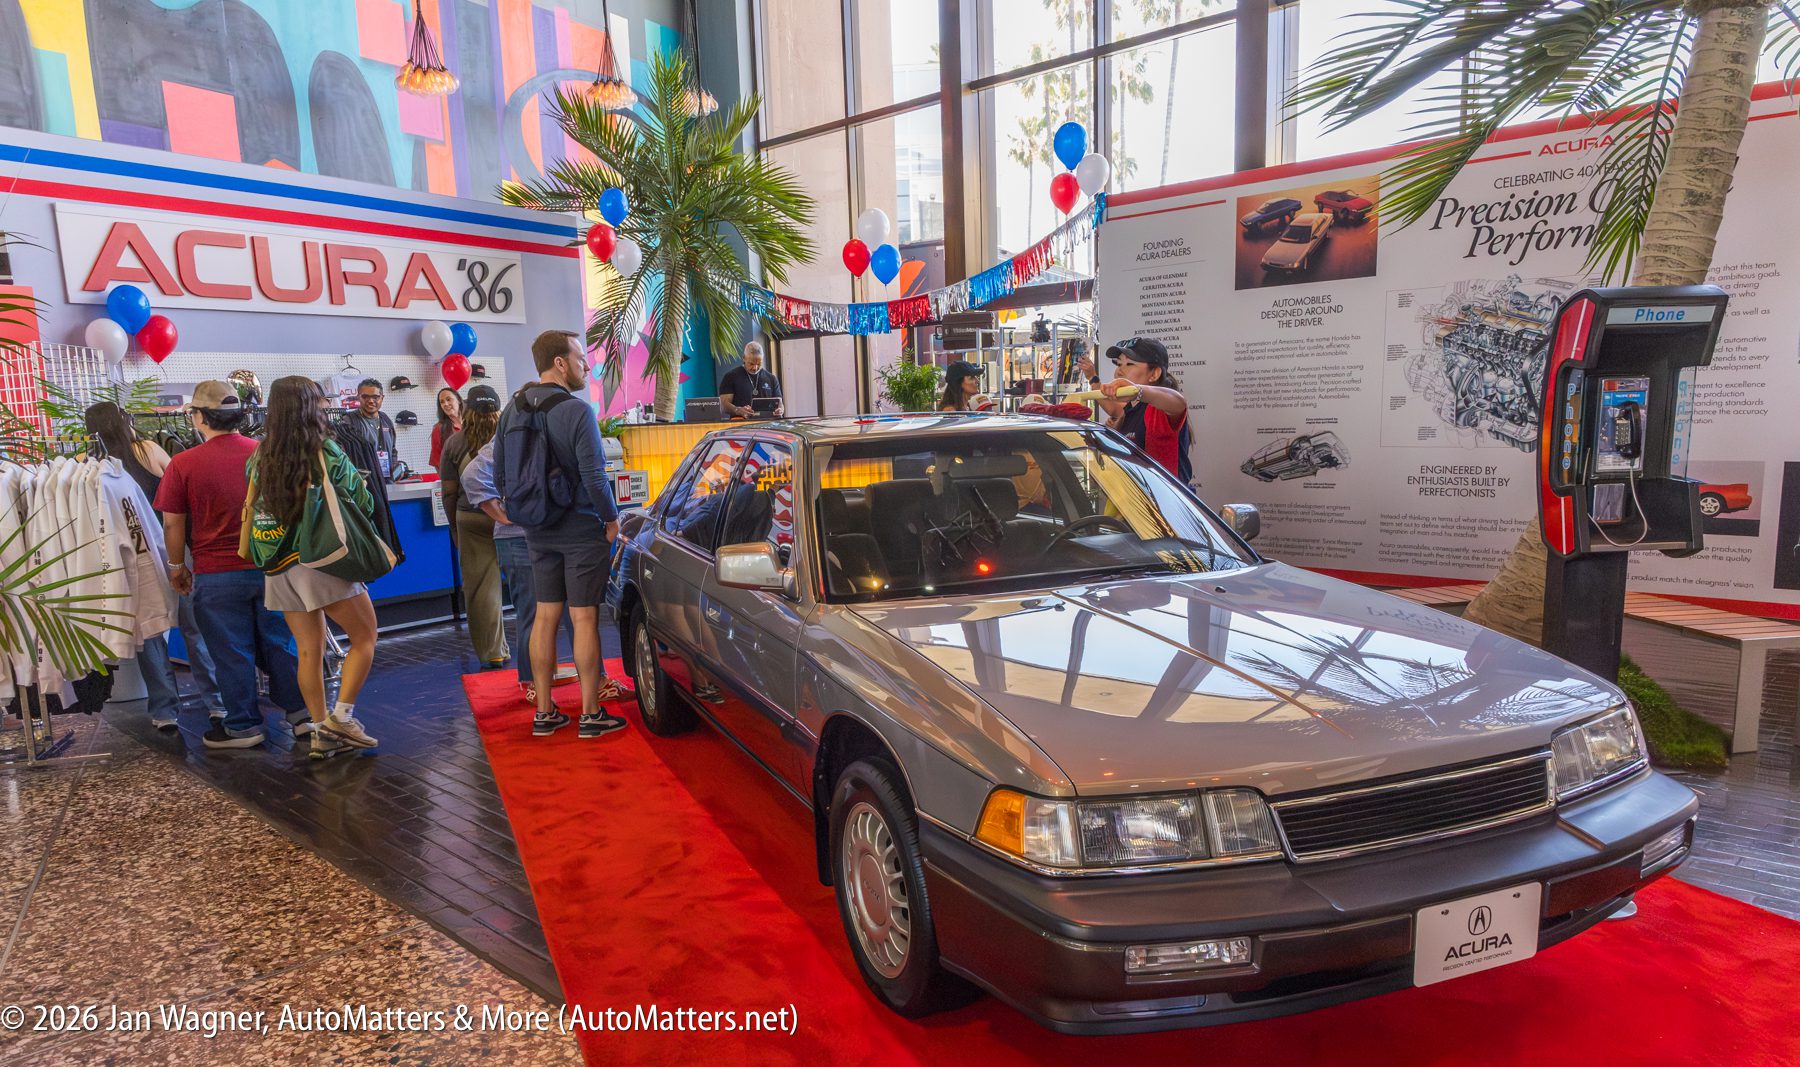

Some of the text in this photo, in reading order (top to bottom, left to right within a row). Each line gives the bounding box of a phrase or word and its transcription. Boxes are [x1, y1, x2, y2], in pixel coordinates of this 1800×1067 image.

[1538, 135, 1616, 157] ACURA
[1494, 168, 1574, 190] CELEBRATING
[1577, 165, 1594, 178] 40
[1429, 190, 1578, 231] Precision
[1144, 238, 1184, 251] FOUNDING
[1462, 219, 1598, 266] Perform
[1136, 247, 1192, 261] ACURA DEALERS
[82, 222, 518, 314] ACURA '86
[1718, 272, 1755, 281] ambitious
[1758, 270, 1780, 280] goals
[1272, 295, 1332, 308] AUTOMOBILES
[1261, 304, 1344, 319] DESIGNED AROUND
[1634, 308, 1686, 321] Phone
[1278, 318, 1324, 328] THE DRIVER.
[1420, 465, 1497, 476] ENGINEERED BY
[1407, 476, 1510, 487] ENTHUSIASTS BUILT BY
[619, 479, 630, 498] NO
[1419, 487, 1496, 498] PERFECTIONISTS
[1712, 546, 1752, 554] production
[1444, 933, 1512, 961] ACURA
